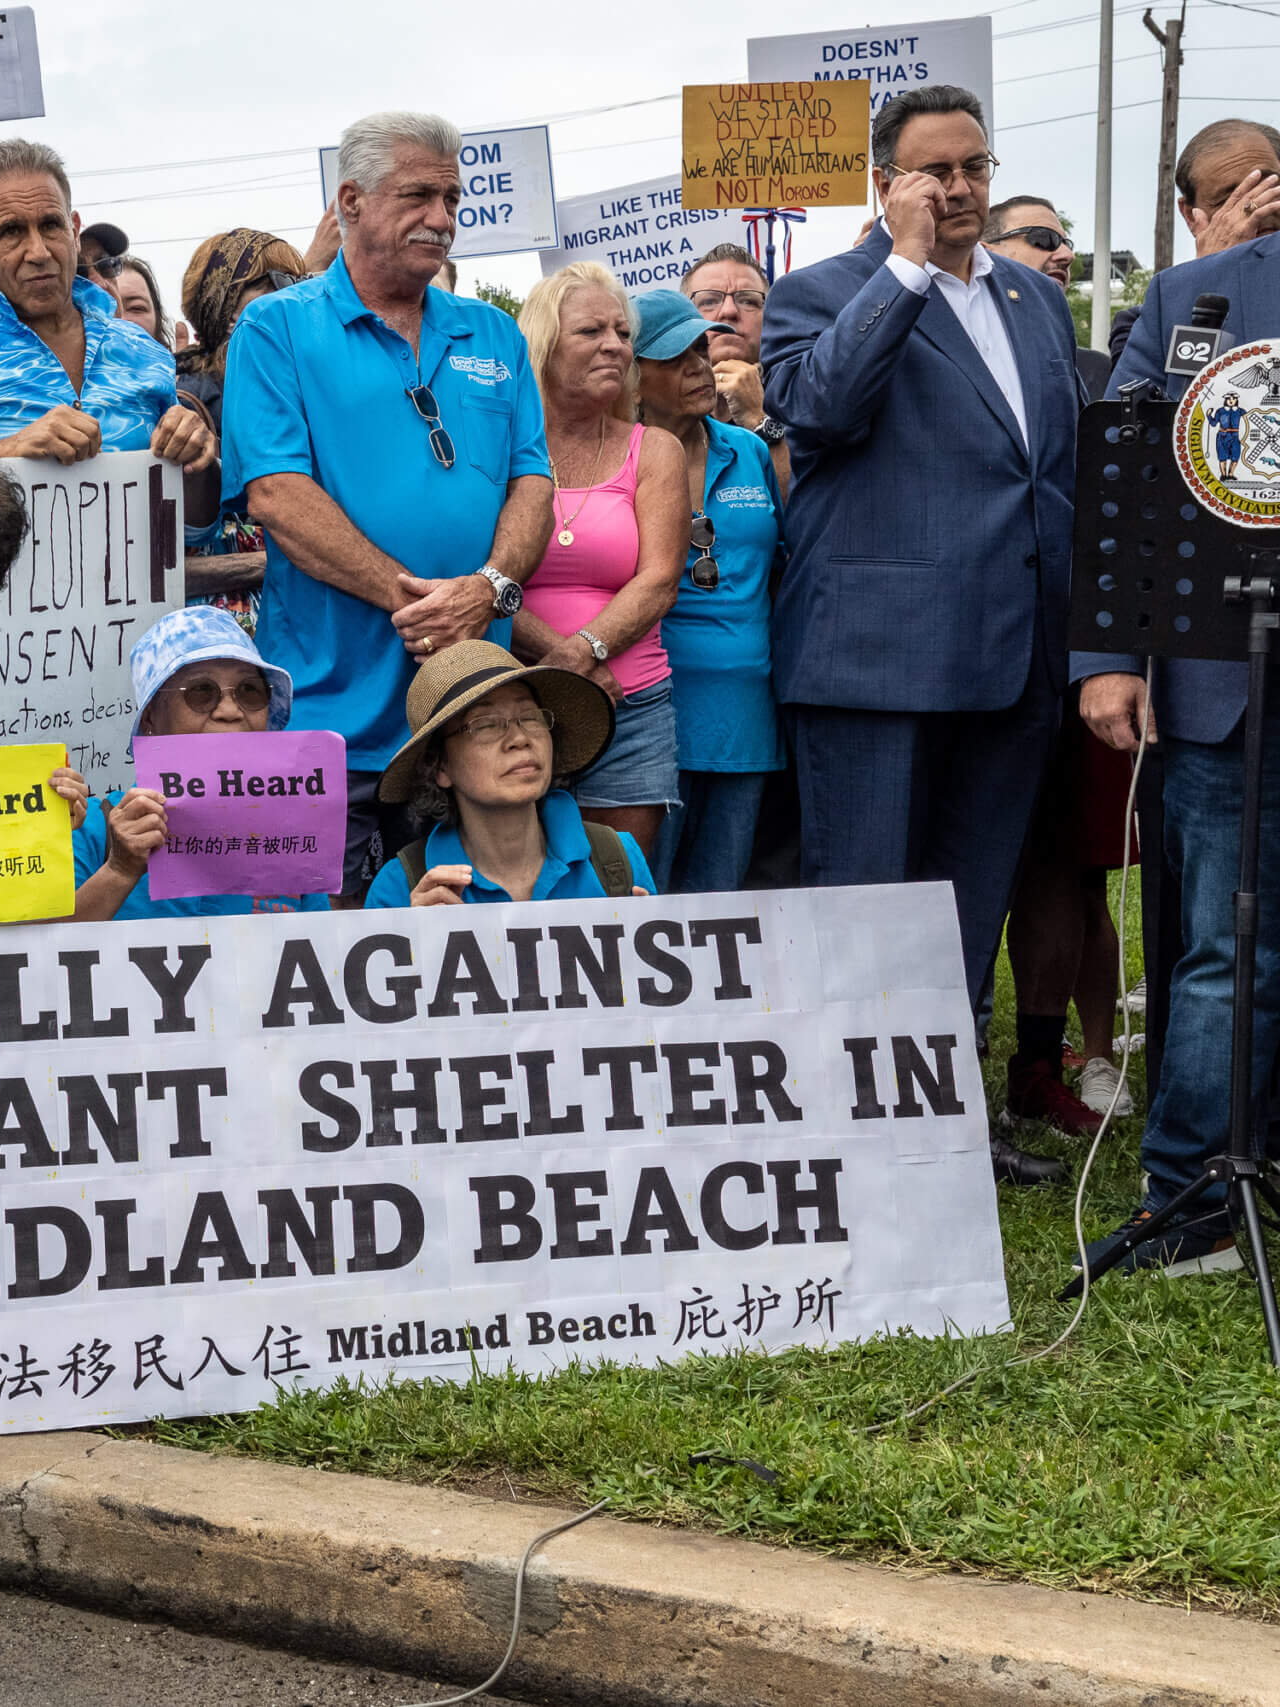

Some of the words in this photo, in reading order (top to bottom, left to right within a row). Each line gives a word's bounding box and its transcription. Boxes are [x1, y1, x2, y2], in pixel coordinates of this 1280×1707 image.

[822, 37, 919, 62] DOESN'T
[719, 81, 814, 103] UNITED
[709, 100, 748, 121] WE
[756, 99, 832, 120] STAND
[716, 118, 837, 140] DIVIDED
[718, 137, 756, 158] WE
[769, 136, 832, 158] FALL
[682, 158, 709, 179] We
[712, 157, 739, 177] ARE
[745, 153, 866, 177] HUMANITARIANS
[600, 196, 643, 219] LIKE
[647, 188, 682, 208] THE
[716, 178, 762, 205] NOT
[563, 218, 650, 250] MIGRANT
[607, 240, 674, 267] THANK
[679, 237, 693, 253] A
[616, 258, 700, 287] MOCRA
[72, 741, 112, 773] The
[159, 772, 206, 798] Be
[217, 768, 326, 797] Heard
[166, 835, 318, 856] 让你的声音被听见
[262, 916, 762, 1029] AGAINST
[298, 1040, 803, 1154] SHELTER
[843, 1033, 966, 1120] IN
[469, 1157, 848, 1263] BEACH
[326, 1312, 511, 1363] Midland
[526, 1302, 656, 1346] Beach
[672, 1277, 843, 1346] 庇护所
